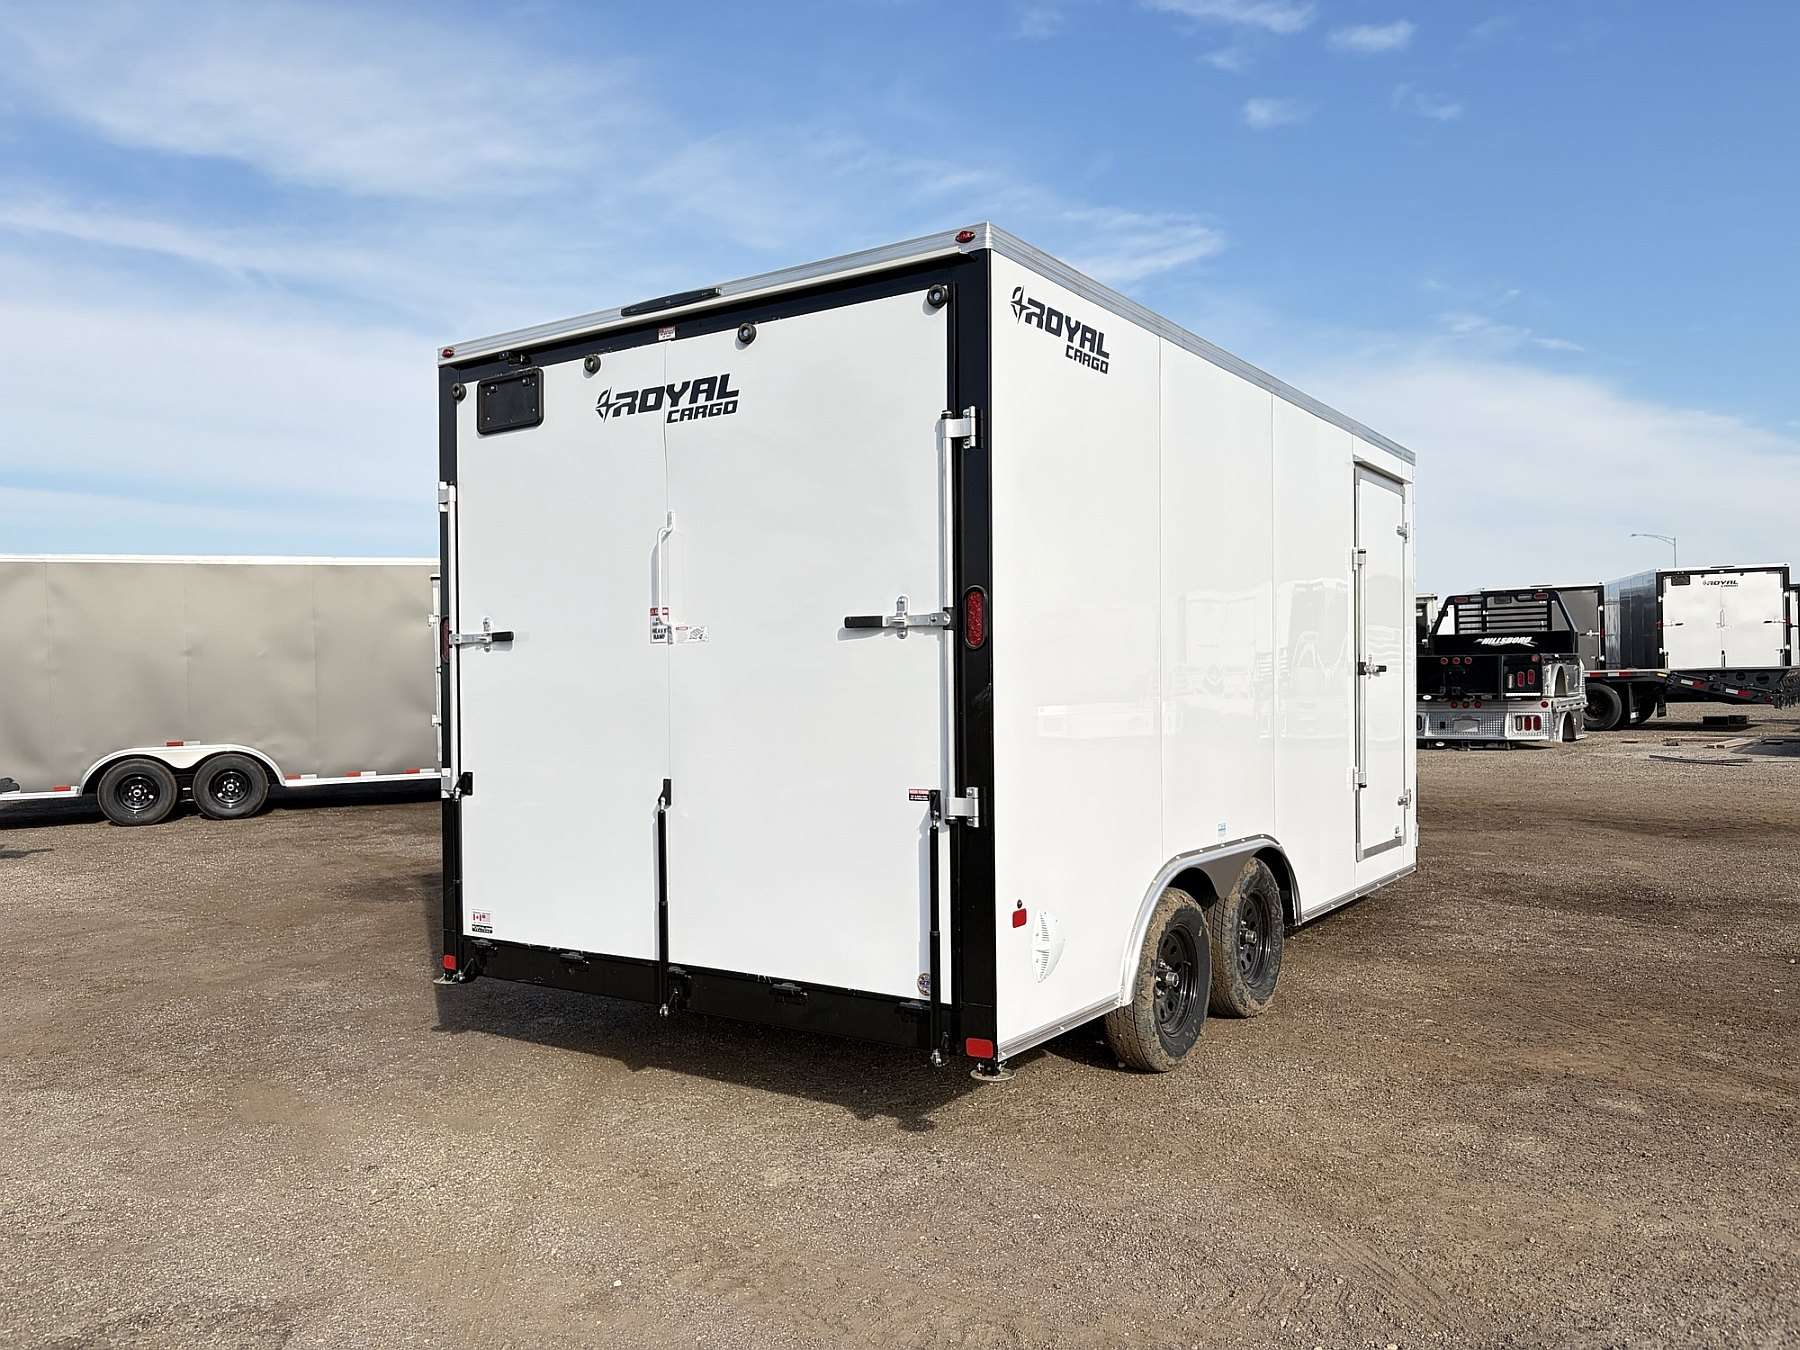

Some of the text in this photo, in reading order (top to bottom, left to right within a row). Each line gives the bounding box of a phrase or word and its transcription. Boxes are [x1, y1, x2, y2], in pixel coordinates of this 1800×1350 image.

[1025, 297, 1110, 360] ROYAL
[1065, 344, 1109, 375] CARGO
[611, 373, 740, 418] ROYAL
[666, 400, 739, 424] CARGO
[1481, 636, 1532, 647] HILLSBORO
